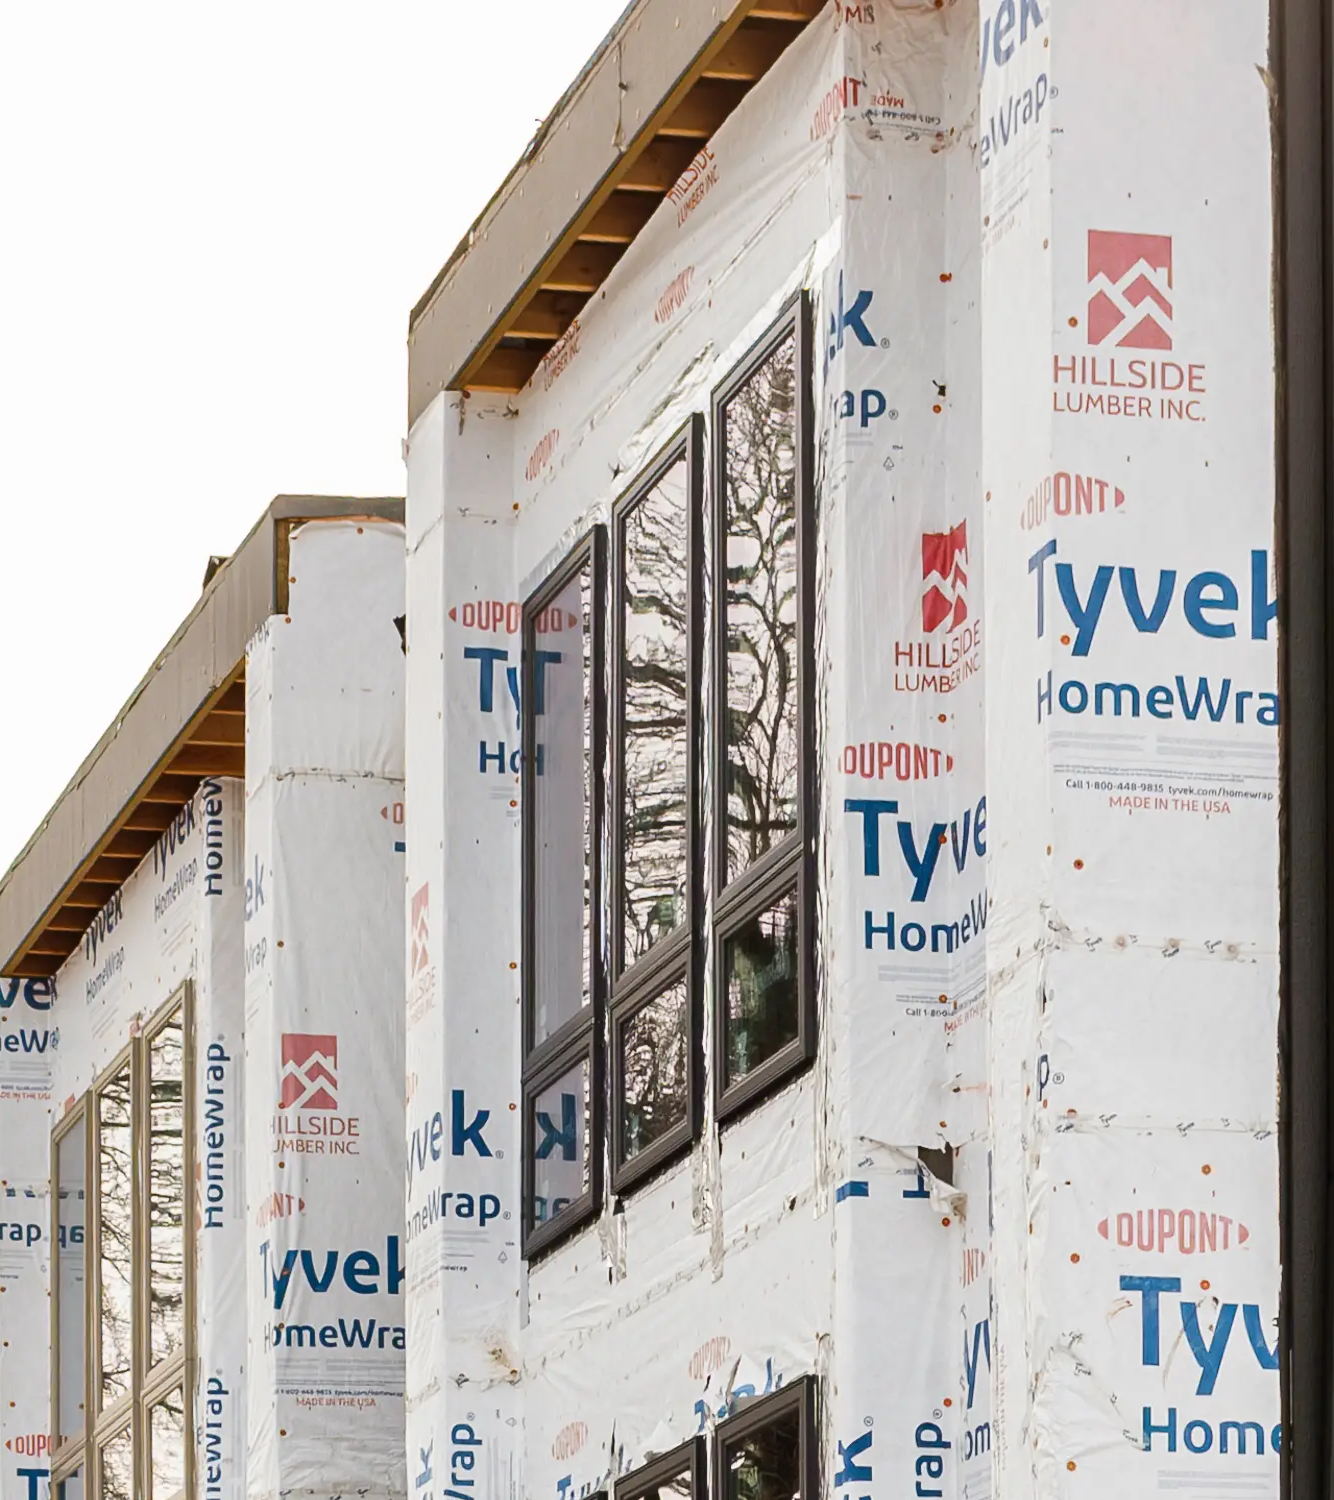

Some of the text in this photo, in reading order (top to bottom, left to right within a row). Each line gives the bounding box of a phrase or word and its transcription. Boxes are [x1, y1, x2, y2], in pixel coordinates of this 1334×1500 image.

[1054, 355, 1206, 393] HILLSIDE
[1053, 393, 1206, 421] LUMBER INC.
[1027, 471, 1109, 530] DUPONT
[895, 620, 981, 668] HILLSIDE
[895, 666, 961, 692] LUMBER
[843, 742, 942, 780] DUPONT
[1066, 779, 1084, 789] Call
[1168, 786, 1274, 801] tyvek.com/homewrap
[1109, 796, 1231, 814] MADE IN THE USA
[205, 1043, 231, 1230] HomeWrap
[1116, 1209, 1234, 1255] DUPONT
[296, 1397, 324, 1407] MADE
[338, 1398, 355, 1407] THE
[357, 1398, 376, 1408] USA
